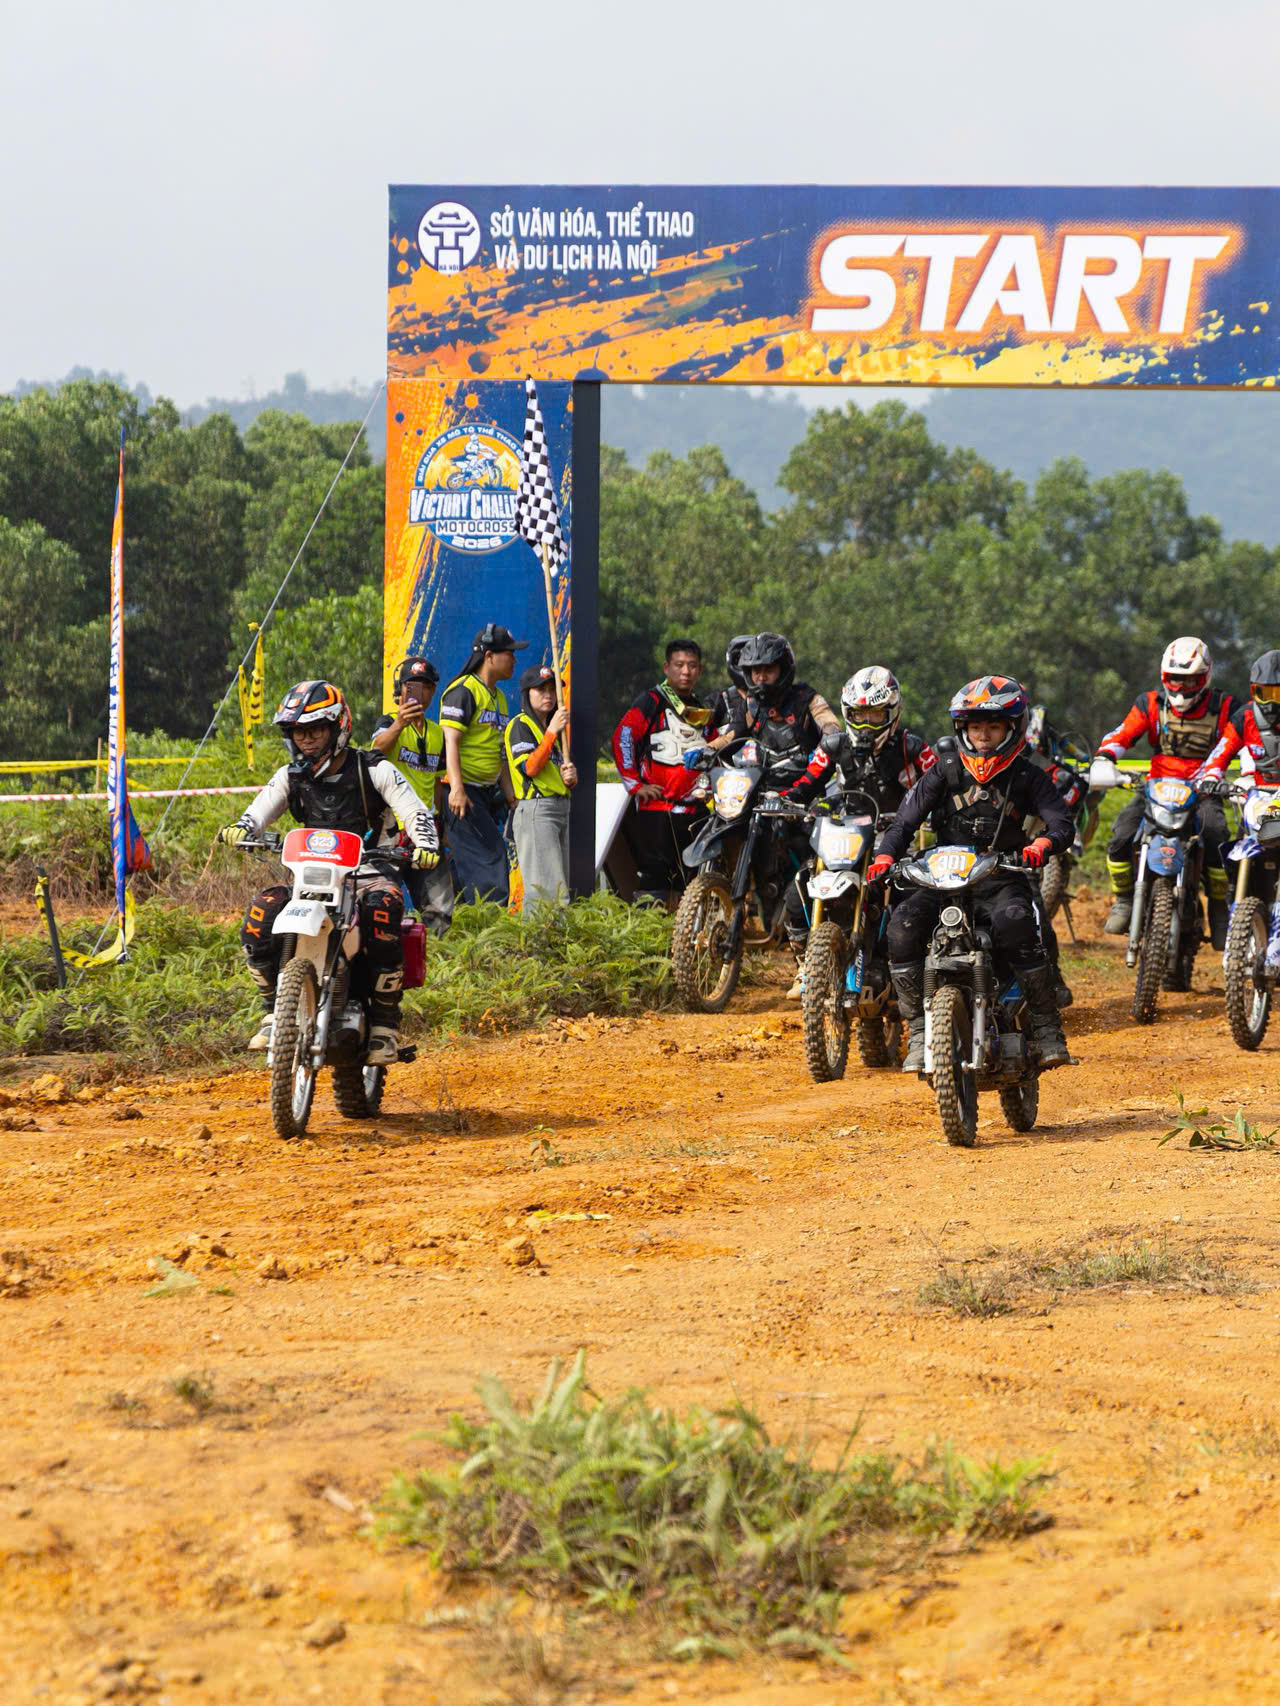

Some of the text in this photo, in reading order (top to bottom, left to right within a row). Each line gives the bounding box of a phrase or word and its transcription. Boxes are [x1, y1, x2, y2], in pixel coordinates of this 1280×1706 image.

[490, 201, 694, 240] SỞ VĂN HÓA, THỂ THAO
[494, 238, 657, 275] VÀ DU LỊCH HÀ NỘI
[811, 233, 1231, 333] START
[437, 520, 516, 534] MOTOCROSS
[451, 535, 503, 549] 2026
[299, 851, 343, 860] HONDA
